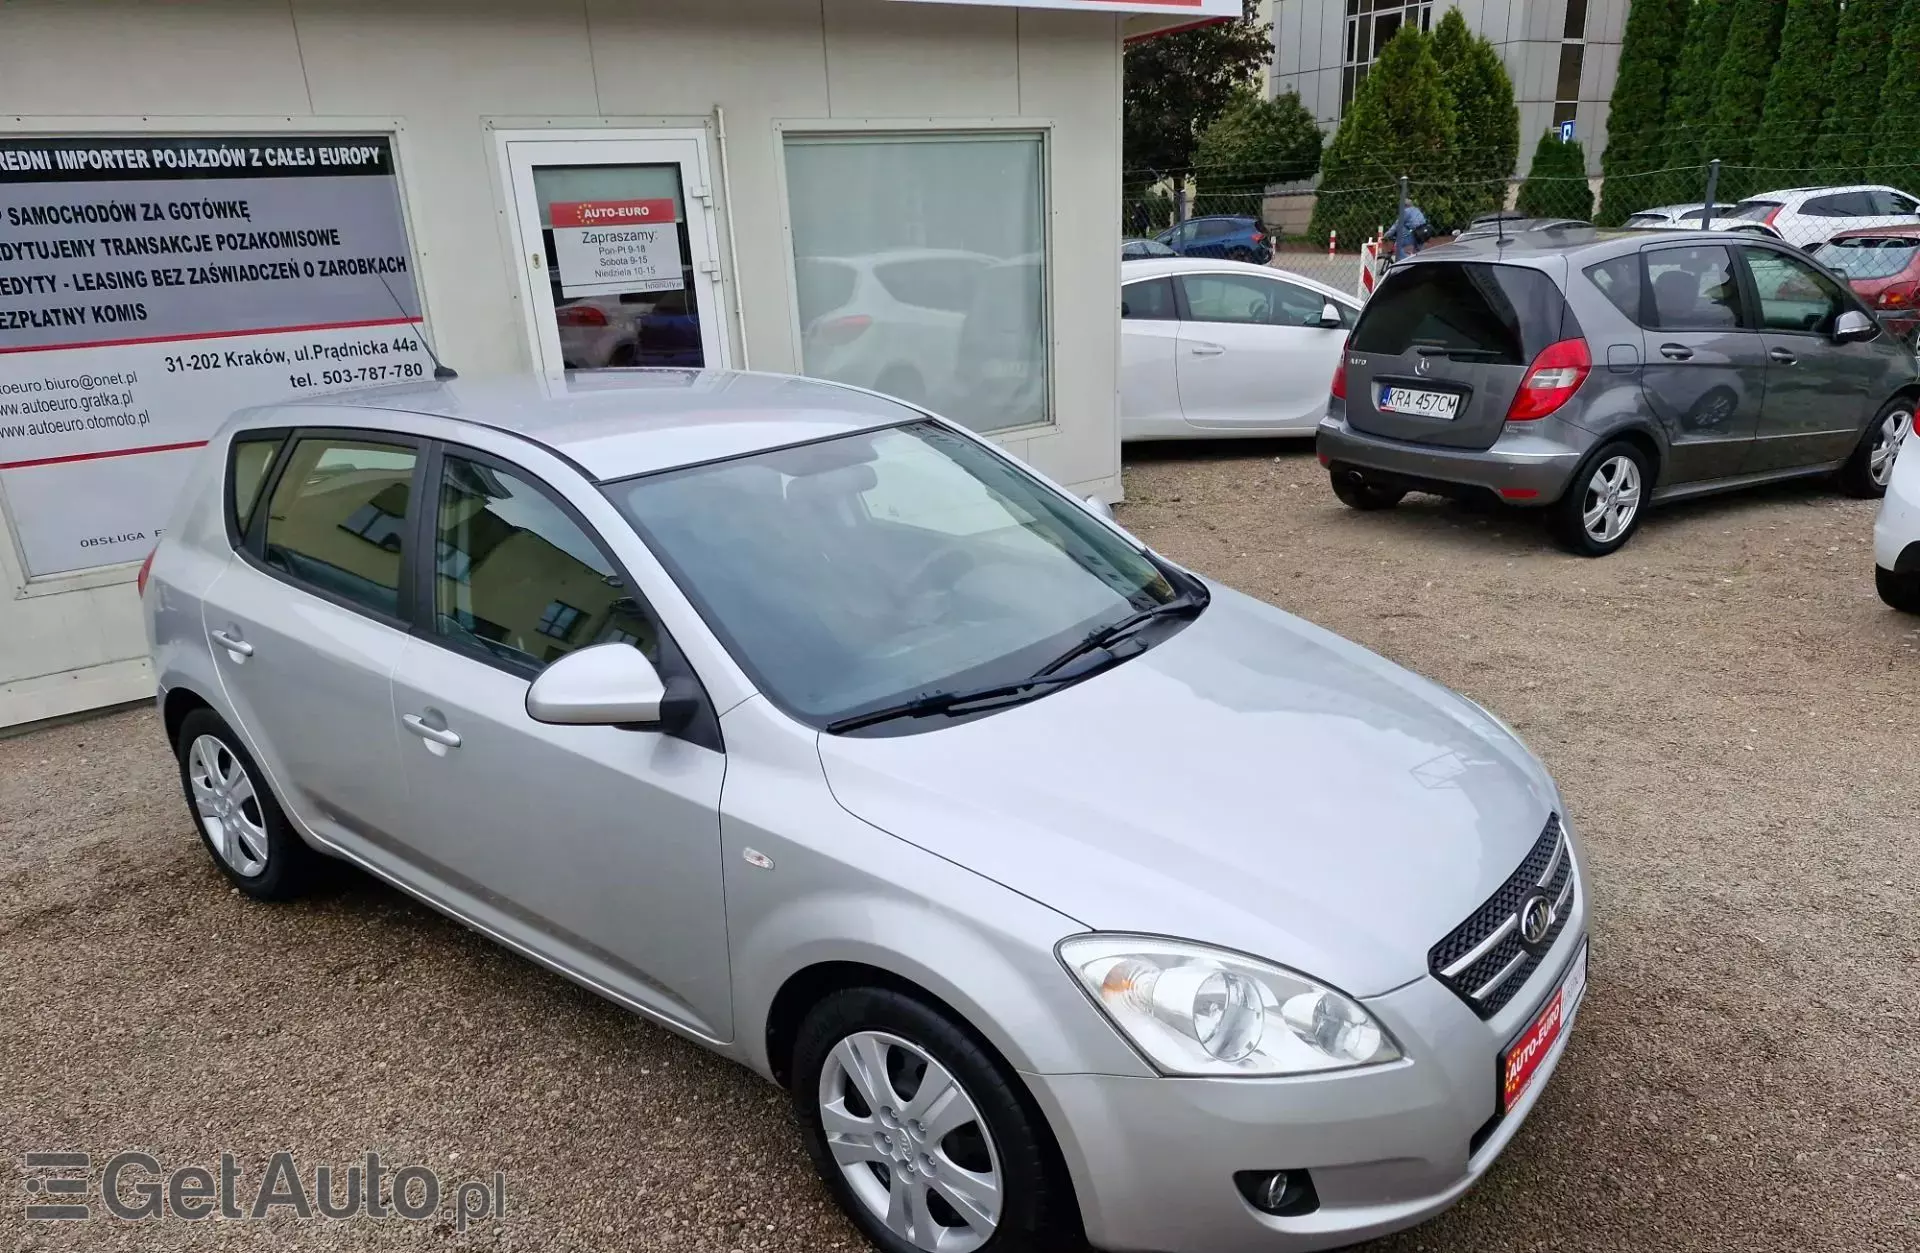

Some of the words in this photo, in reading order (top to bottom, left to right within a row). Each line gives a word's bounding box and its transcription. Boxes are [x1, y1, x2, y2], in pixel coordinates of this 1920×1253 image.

[55, 149, 150, 169] IMPORTER
[153, 144, 246, 168] POJAZDÓW
[250, 148, 262, 167] Z
[265, 147, 315, 166] CAŁEJ
[319, 146, 379, 165] EUROPY
[7, 200, 136, 226] SAMOCHODÓW
[140, 203, 165, 221] ZA
[168, 197, 251, 222] GOTÓWKĘ
[584, 206, 649, 218] AUTO-EURO
[0, 239, 96, 261] DYTUJEMY
[101, 234, 213, 256] TRANSAKCJE
[216, 229, 340, 251] POZAKOMISOWE
[72, 270, 148, 291] LEASING
[151, 268, 185, 287] BEZ
[187, 258, 300, 285] ZAŚWIADCZEŃ
[303, 261, 315, 278] O
[318, 256, 407, 277] ZAROBKACH
[595, 268, 632, 278] Niedziela
[600, 257, 628, 267] Sobota
[630, 255, 648, 265] 9-15
[91, 303, 148, 323] KOMIS
[165, 352, 222, 373] 31-202
[225, 348, 291, 368] Kraków,
[294, 340, 389, 362] ul.Prądnicka
[392, 337, 418, 353] 44a
[290, 373, 318, 388] tel.
[323, 362, 423, 385] 503-787-780
[1387, 389, 1412, 408] KRA
[1416, 392, 1458, 414] 457CM
[80, 532, 145, 548] OBSŁUGA
[1509, 1003, 1560, 1082] AUTO-EURO
